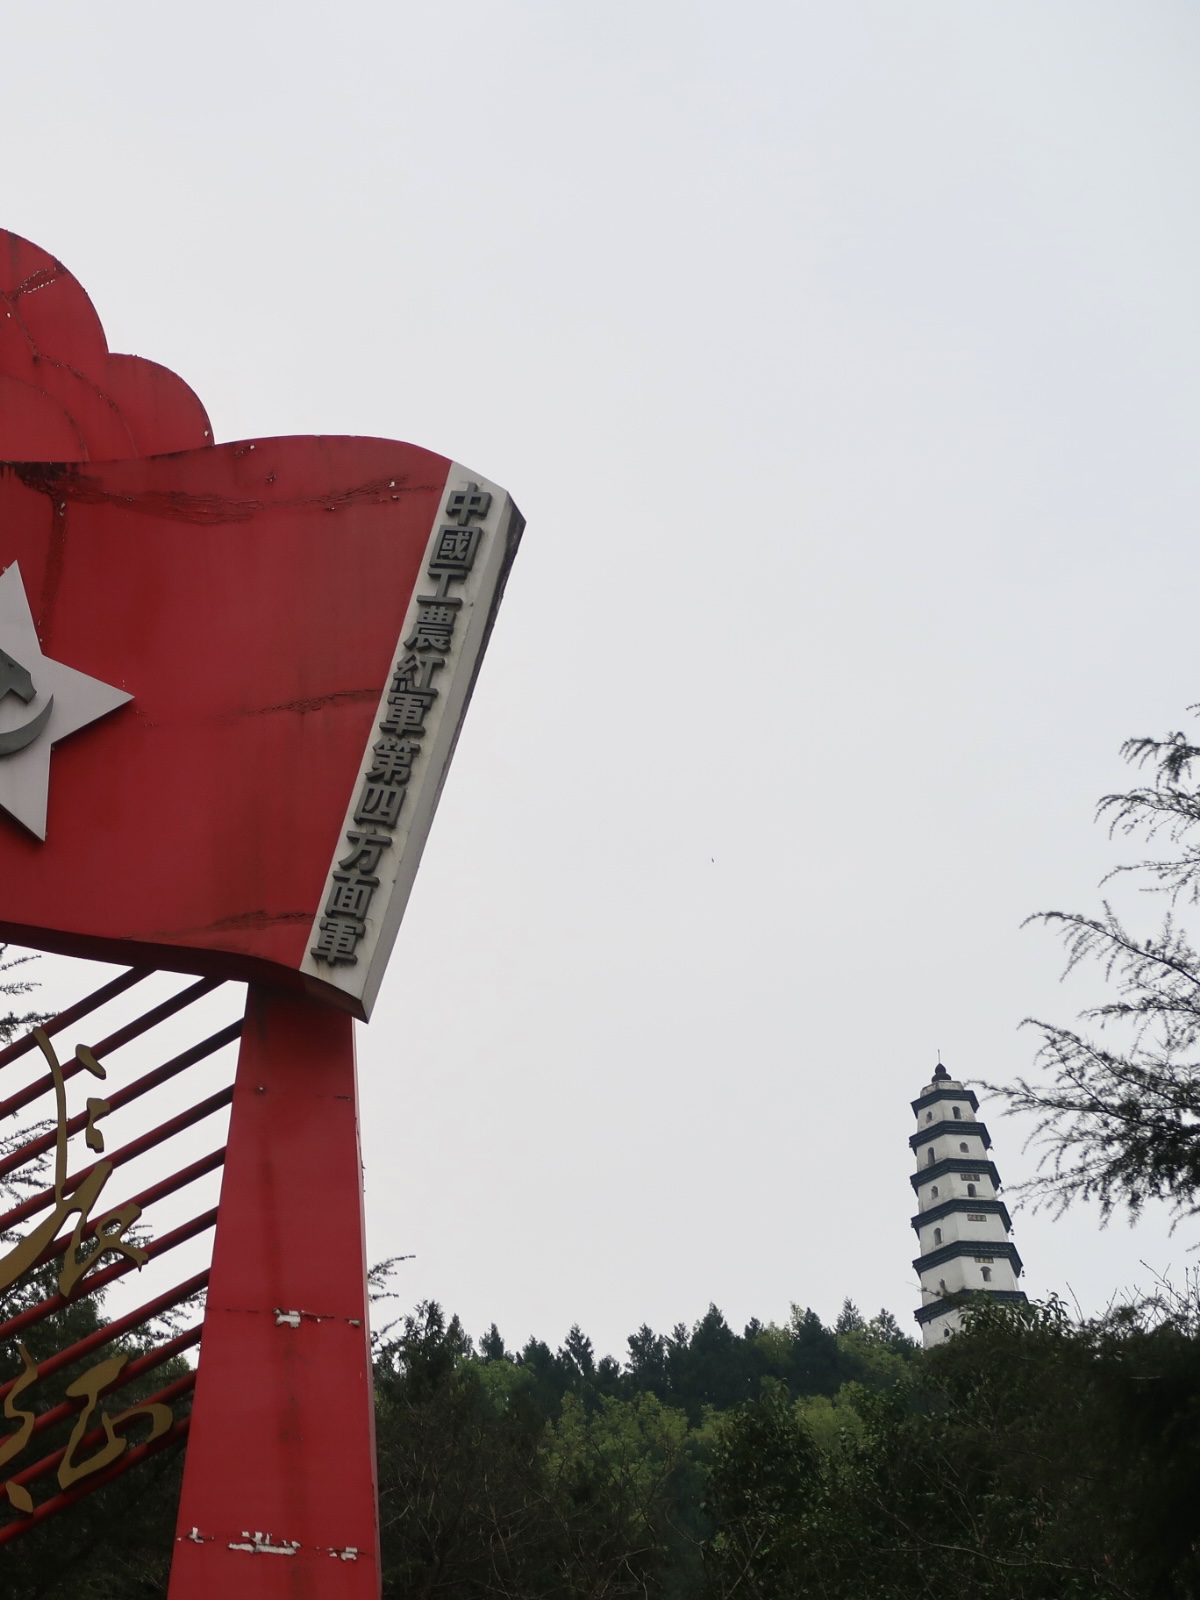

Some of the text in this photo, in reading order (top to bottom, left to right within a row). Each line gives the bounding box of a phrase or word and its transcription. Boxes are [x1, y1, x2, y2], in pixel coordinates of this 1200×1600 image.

[310, 482, 492, 966] 中國工農紅軍第四方面軍
